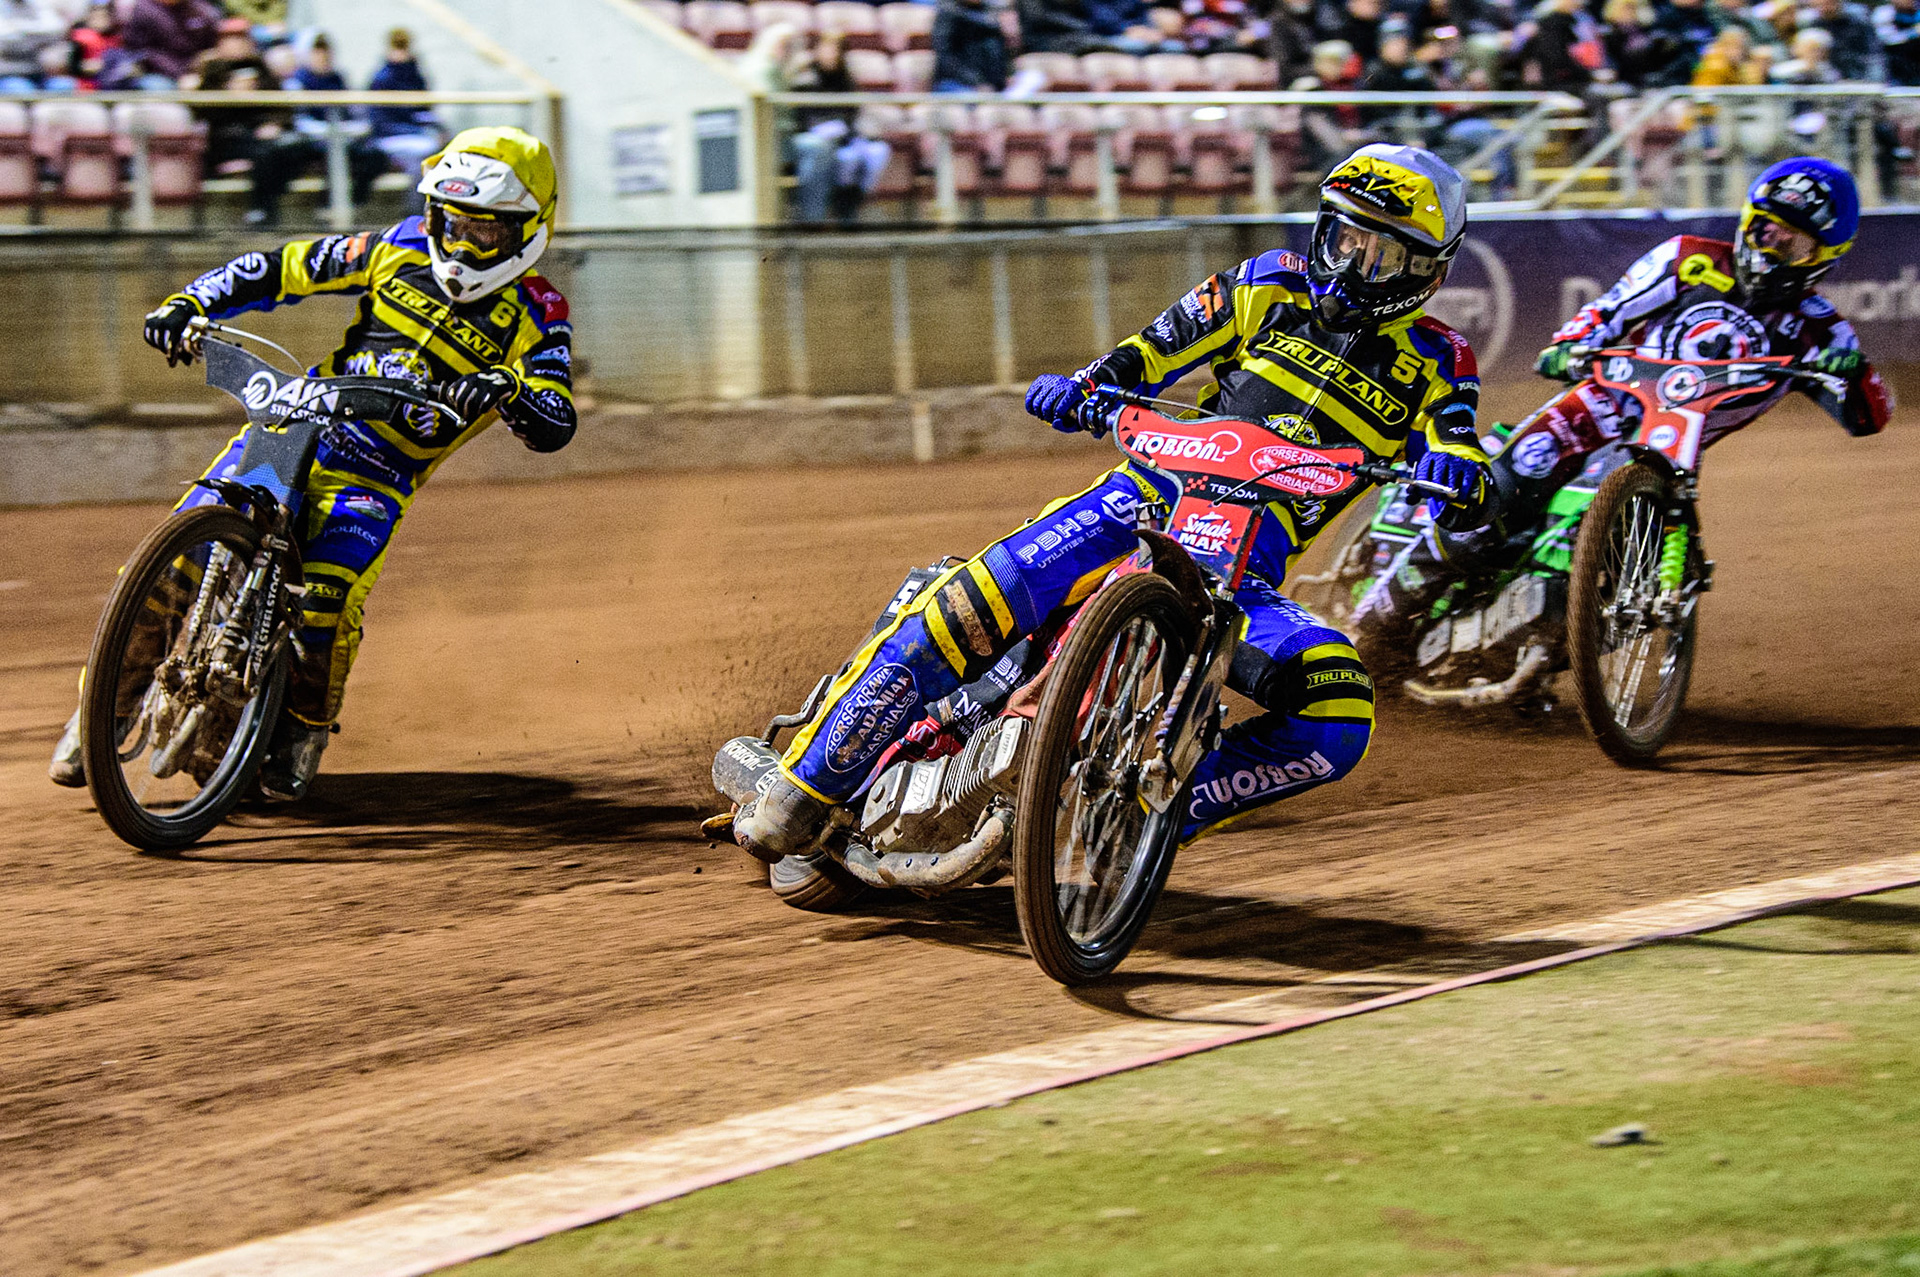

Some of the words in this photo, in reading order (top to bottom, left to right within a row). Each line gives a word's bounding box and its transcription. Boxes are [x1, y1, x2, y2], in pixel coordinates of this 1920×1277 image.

[1349, 185, 1387, 208] TEXOM
[389, 283, 431, 314] TRU
[489, 299, 517, 328] 6
[1372, 290, 1431, 317] TEXOM
[1273, 336, 1318, 366] TRU
[1317, 359, 1401, 418] PLANT
[1390, 350, 1423, 385] 5
[269, 403, 332, 427] STELSTOCK
[1209, 483, 1258, 501] TEXOM
[1015, 509, 1101, 565] PBHS
[1037, 536, 1086, 569] UTILITIES
[1087, 525, 1105, 540] LTD
[1178, 532, 1226, 553] MAK
[259, 563, 282, 646] STEELSTOCK
[1312, 671, 1339, 685] TRU
[859, 674, 910, 741] ADAMIAK
